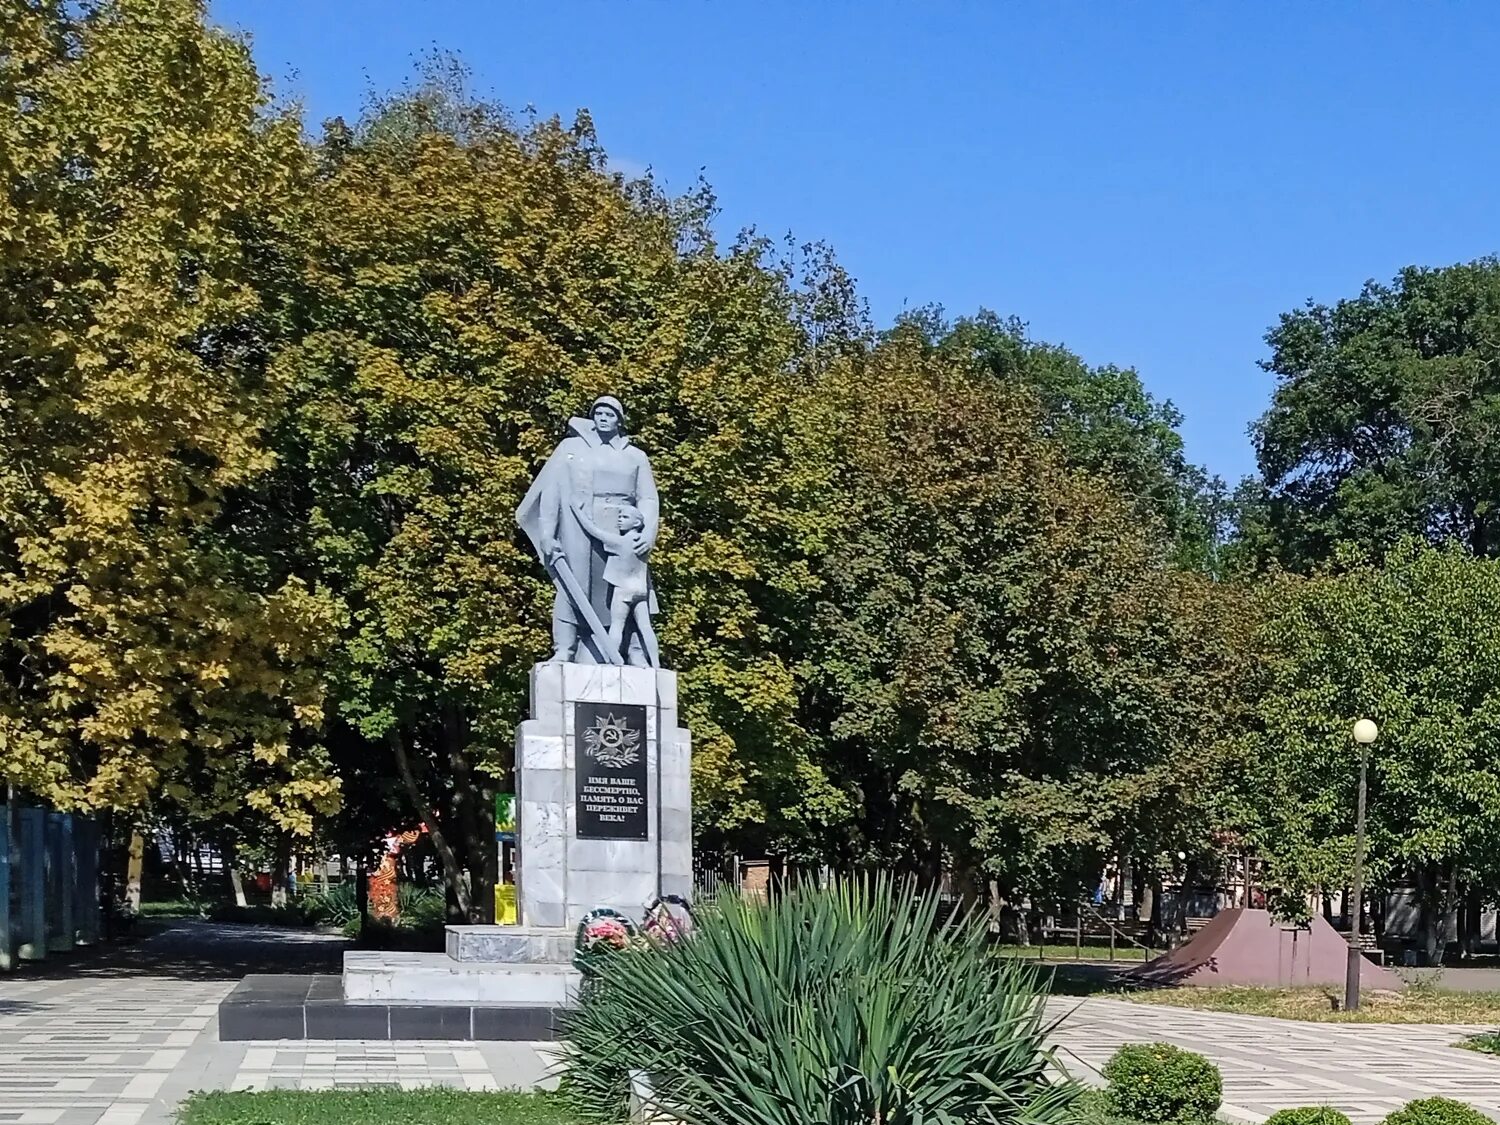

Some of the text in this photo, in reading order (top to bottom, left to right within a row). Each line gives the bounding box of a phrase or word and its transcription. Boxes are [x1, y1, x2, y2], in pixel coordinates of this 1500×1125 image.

[610, 778, 636, 786] ВАШЕ
[583, 786, 641, 796] БЕССМЕРТНО,
[580, 795, 617, 803] ПАМЯТЬ
[626, 797, 644, 805] ВАС
[586, 804, 638, 813] ПЕРЕЖИВЕТ
[599, 814, 626, 822] ВЕКА!
